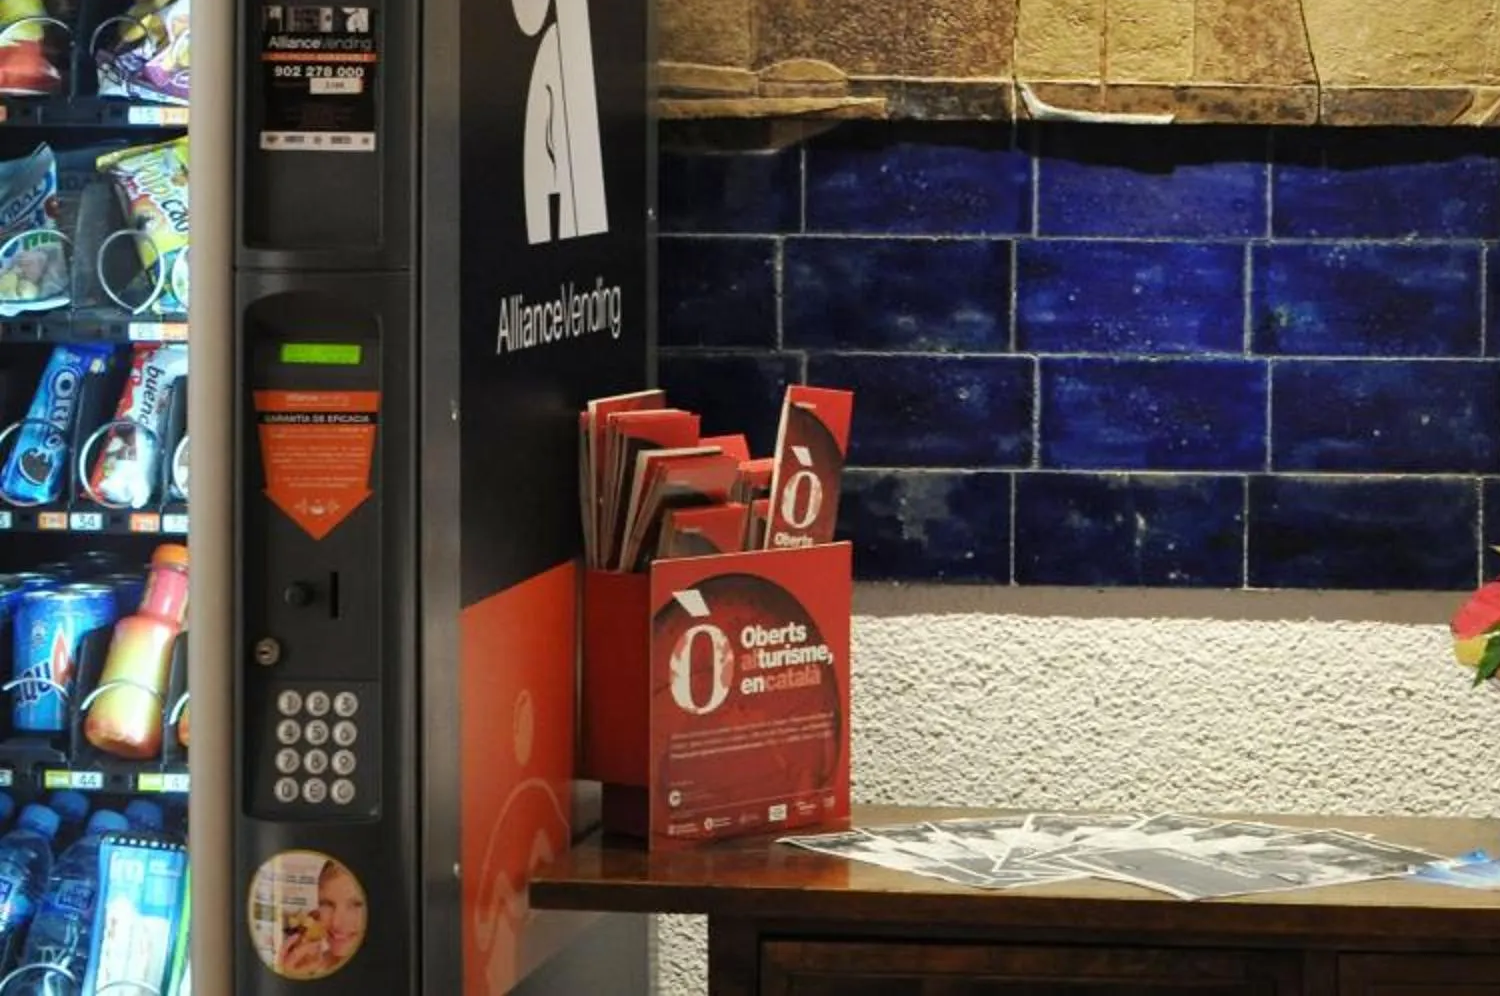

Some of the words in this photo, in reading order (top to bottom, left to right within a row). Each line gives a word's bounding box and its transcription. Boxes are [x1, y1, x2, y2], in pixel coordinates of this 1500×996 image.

[274, 65, 302, 77] 902
[305, 65, 333, 77] 278
[336, 65, 365, 77] 000
[497, 276, 621, 355] AllianceVending
[741, 621, 807, 649] Oberts
